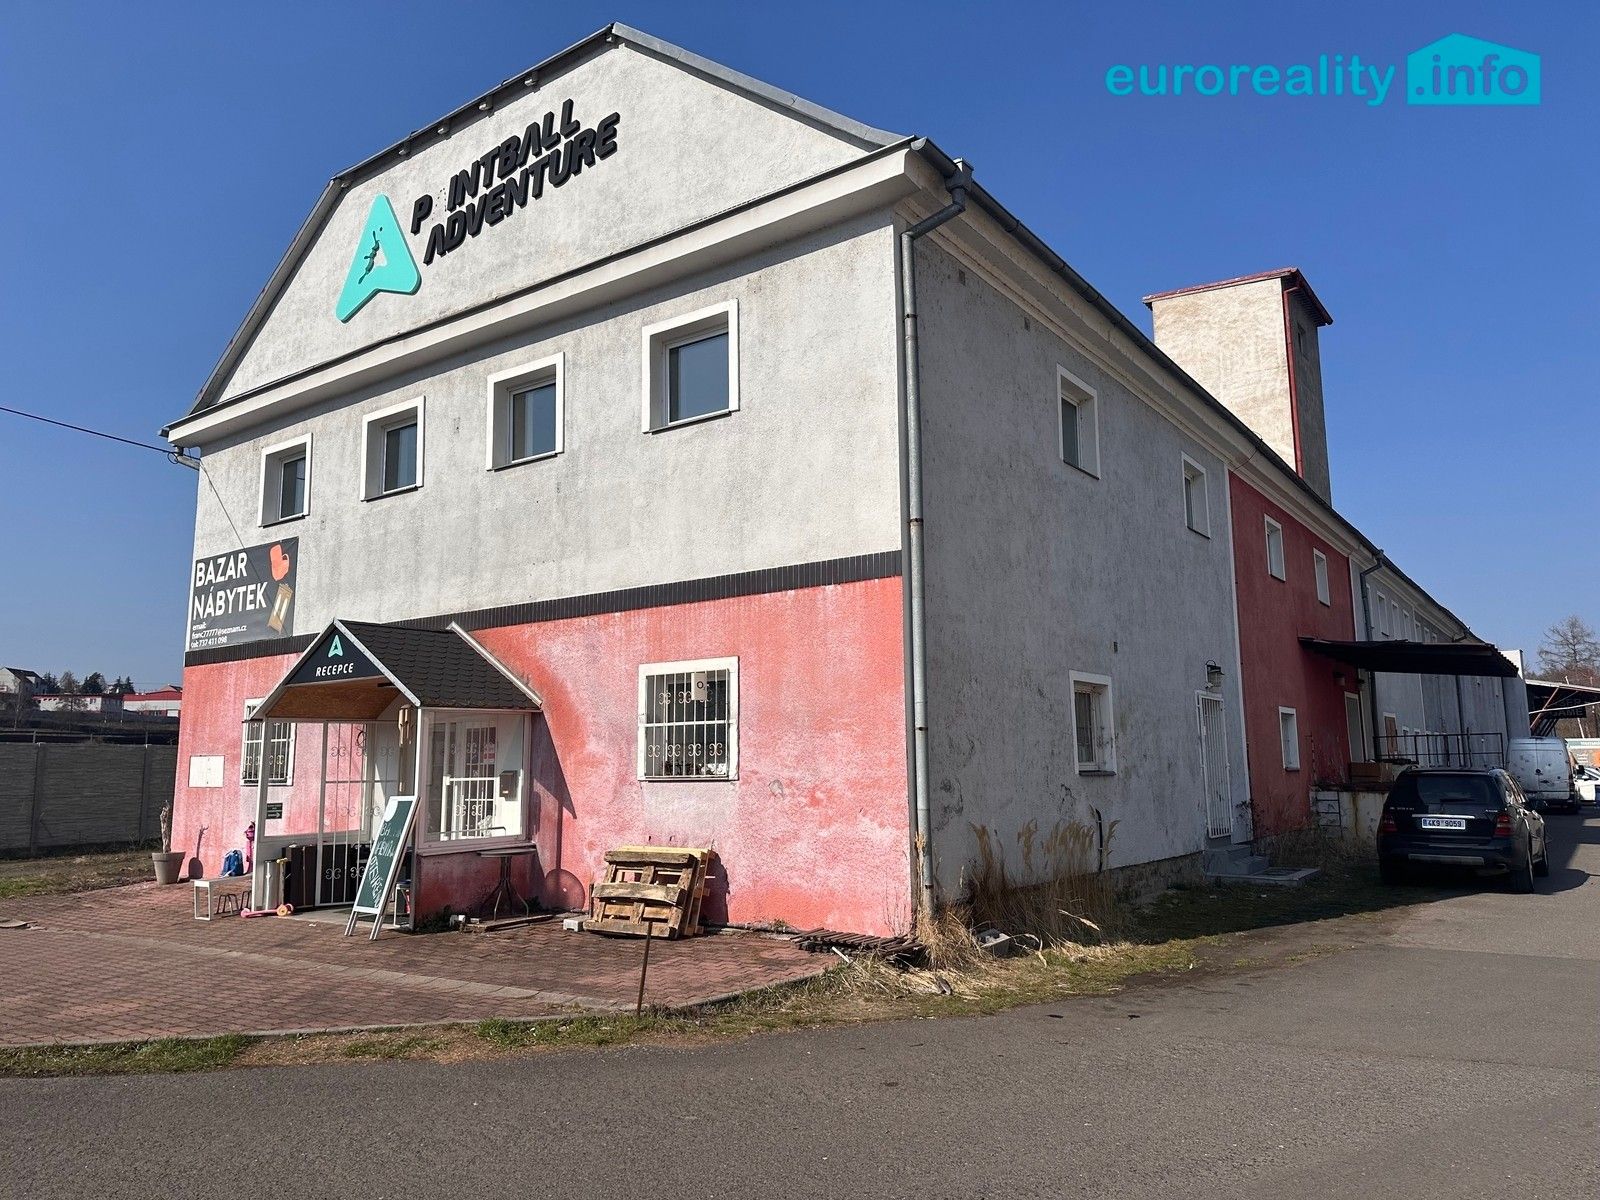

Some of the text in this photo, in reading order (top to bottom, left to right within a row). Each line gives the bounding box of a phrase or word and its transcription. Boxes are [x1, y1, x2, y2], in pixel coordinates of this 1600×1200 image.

[411, 98, 580, 235] PINTBALL
[423, 112, 620, 266] ADVENTURE
[195, 552, 248, 588] BAZAR
[193, 581, 268, 621] NÁBYTEK
[315, 662, 354, 677] RECEPCE
